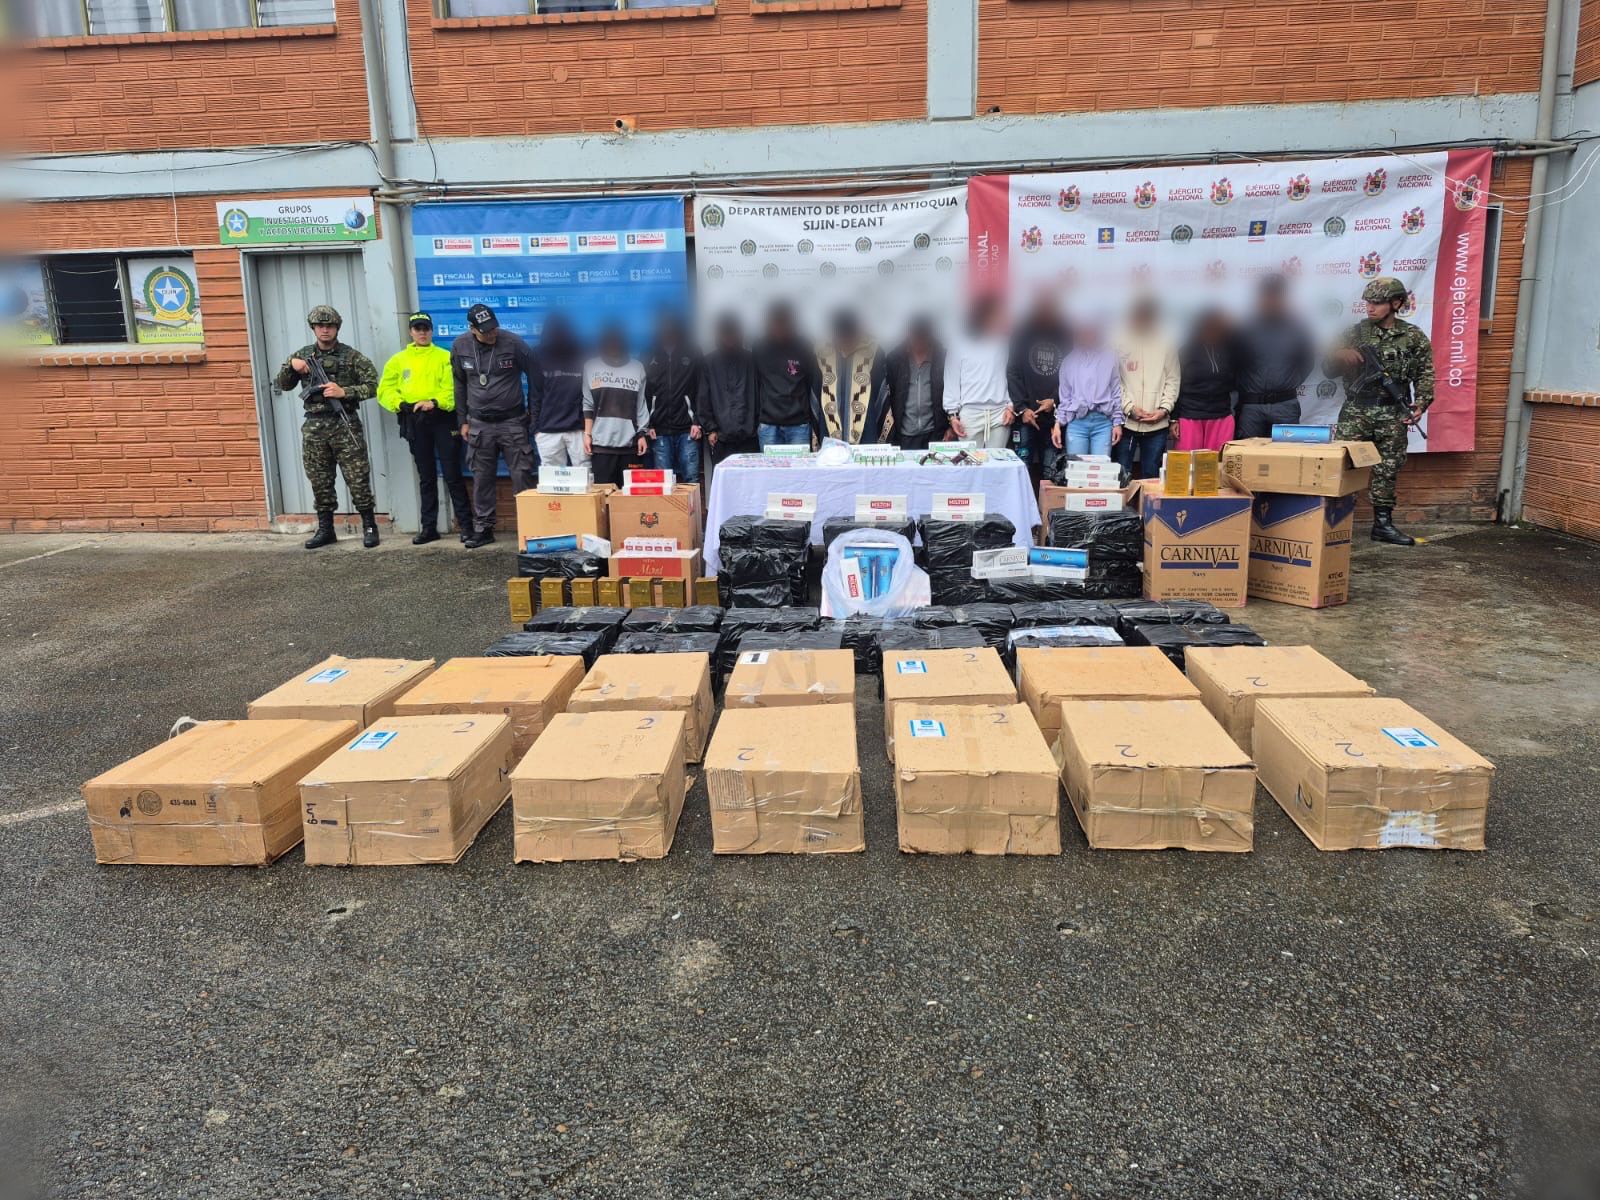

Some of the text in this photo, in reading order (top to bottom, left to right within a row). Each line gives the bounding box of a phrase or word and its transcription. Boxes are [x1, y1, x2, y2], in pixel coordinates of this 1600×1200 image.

[278, 205, 312, 214] GRUPOS
[728, 196, 958, 217] DEPARTAMENTO DE POLICÍA ANTIOQUIA
[264, 215, 329, 225] INVESTIGATIVOS
[803, 216, 885, 231] SIJIN-DEANT
[1449, 232, 1470, 387] www.ejercito.mil.co
[1160, 546, 1240, 565] CARNIVAL
[1251, 538, 1312, 562] ARNIVAL
[963, 653, 979, 663] 2
[636, 717, 655, 730] 2
[990, 712, 1009, 724] 2
[452, 721, 475, 734] 2
